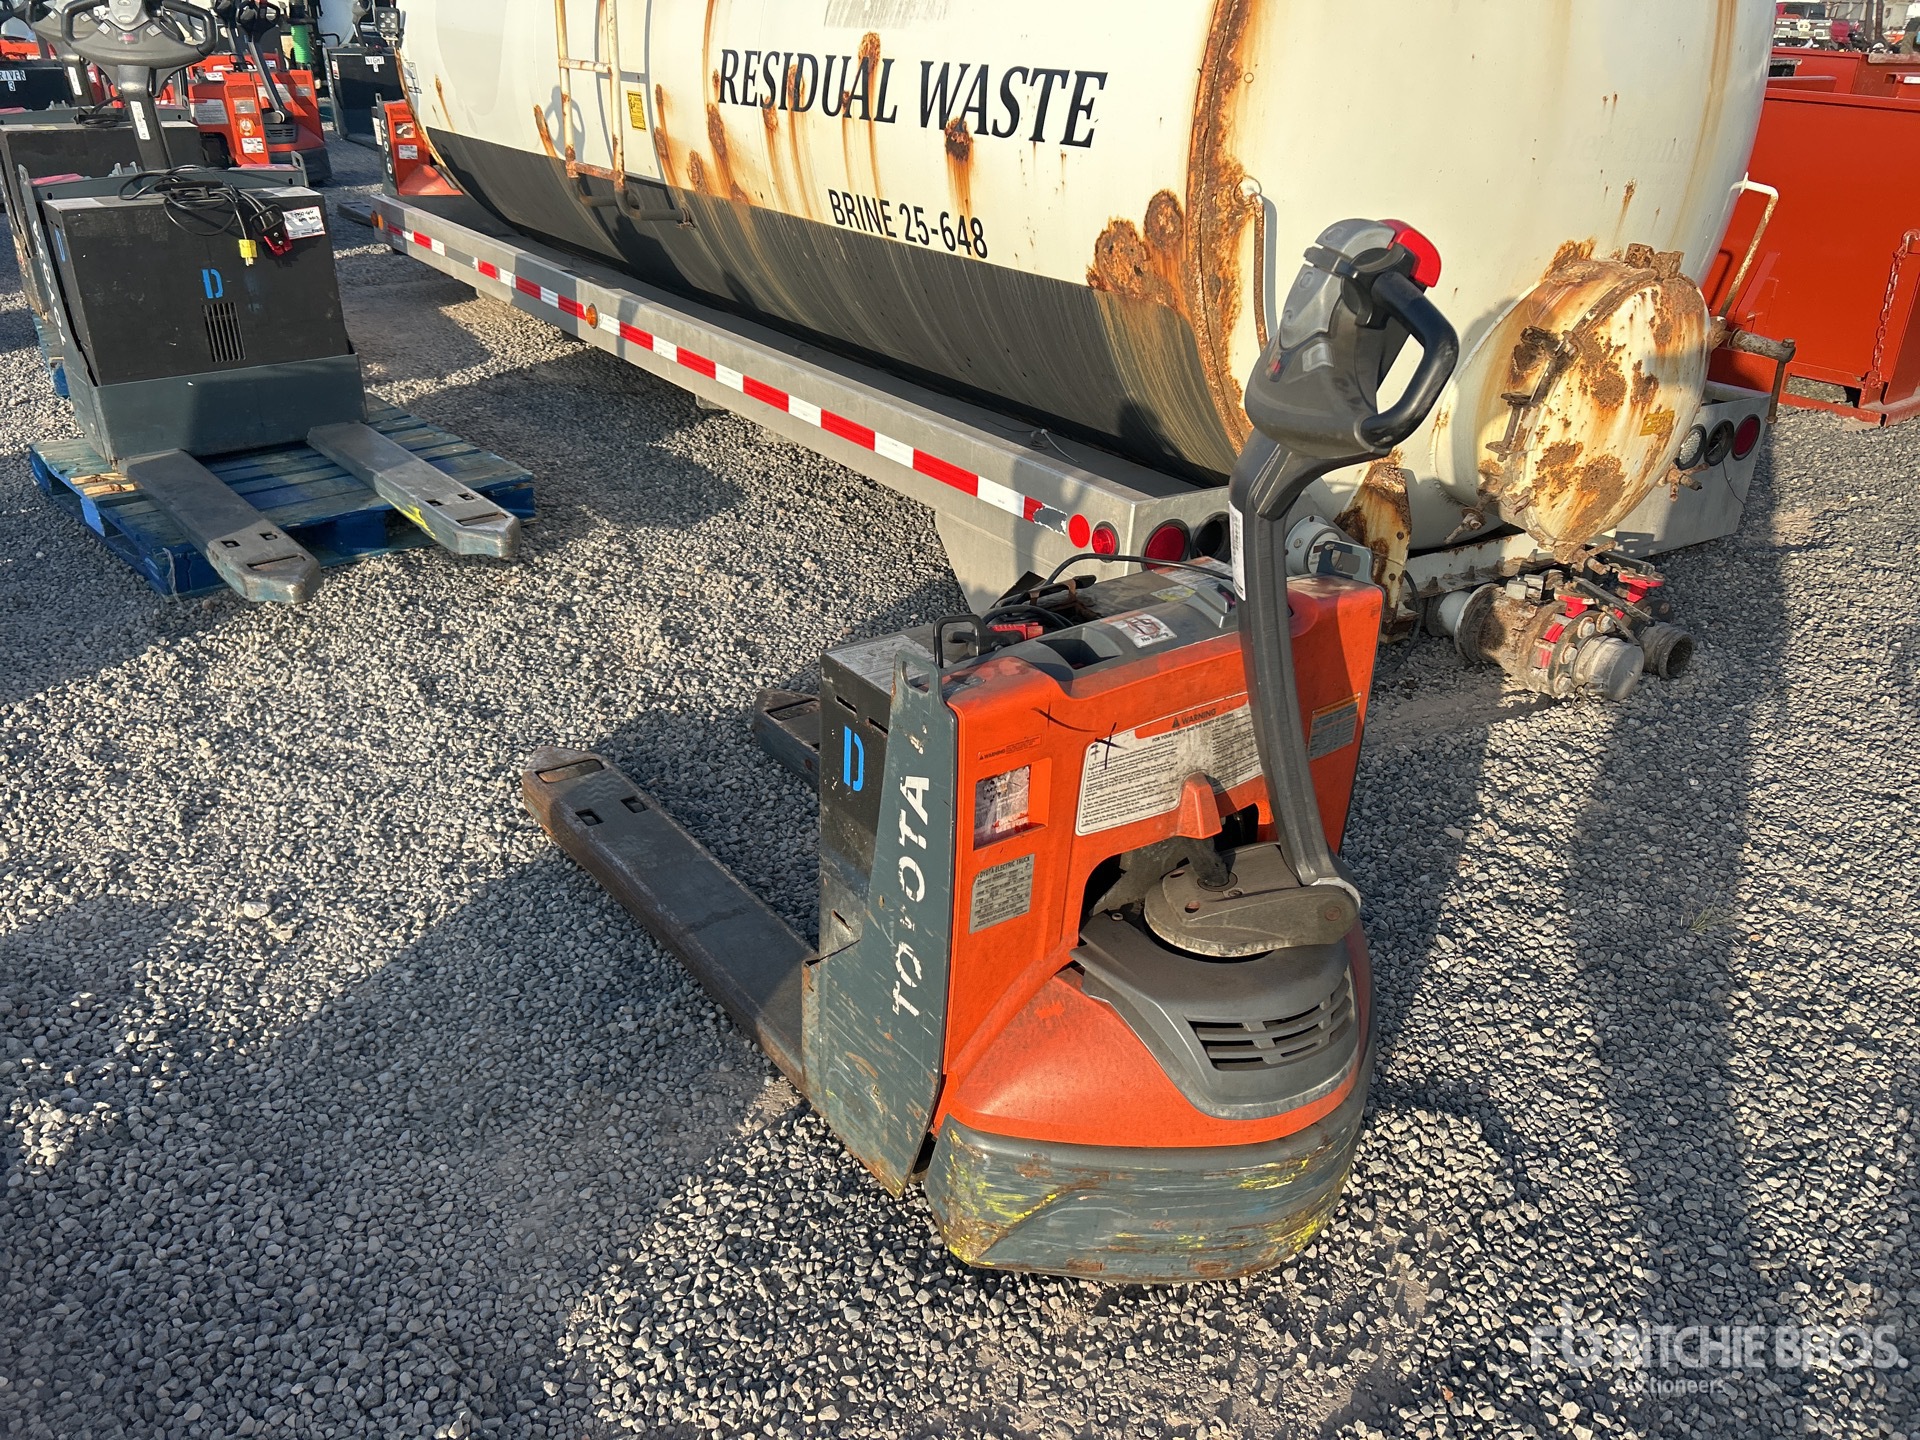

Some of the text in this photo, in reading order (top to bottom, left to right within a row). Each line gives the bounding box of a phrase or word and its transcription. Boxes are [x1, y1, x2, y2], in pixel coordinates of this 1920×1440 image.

[718, 48, 898, 124] RESIDUAL
[920, 60, 1109, 148] WASTE
[828, 188, 988, 260] BRINE 25-648
[202, 268, 224, 299] D
[1181, 708, 1217, 725] WARNING
[843, 725, 865, 793] D
